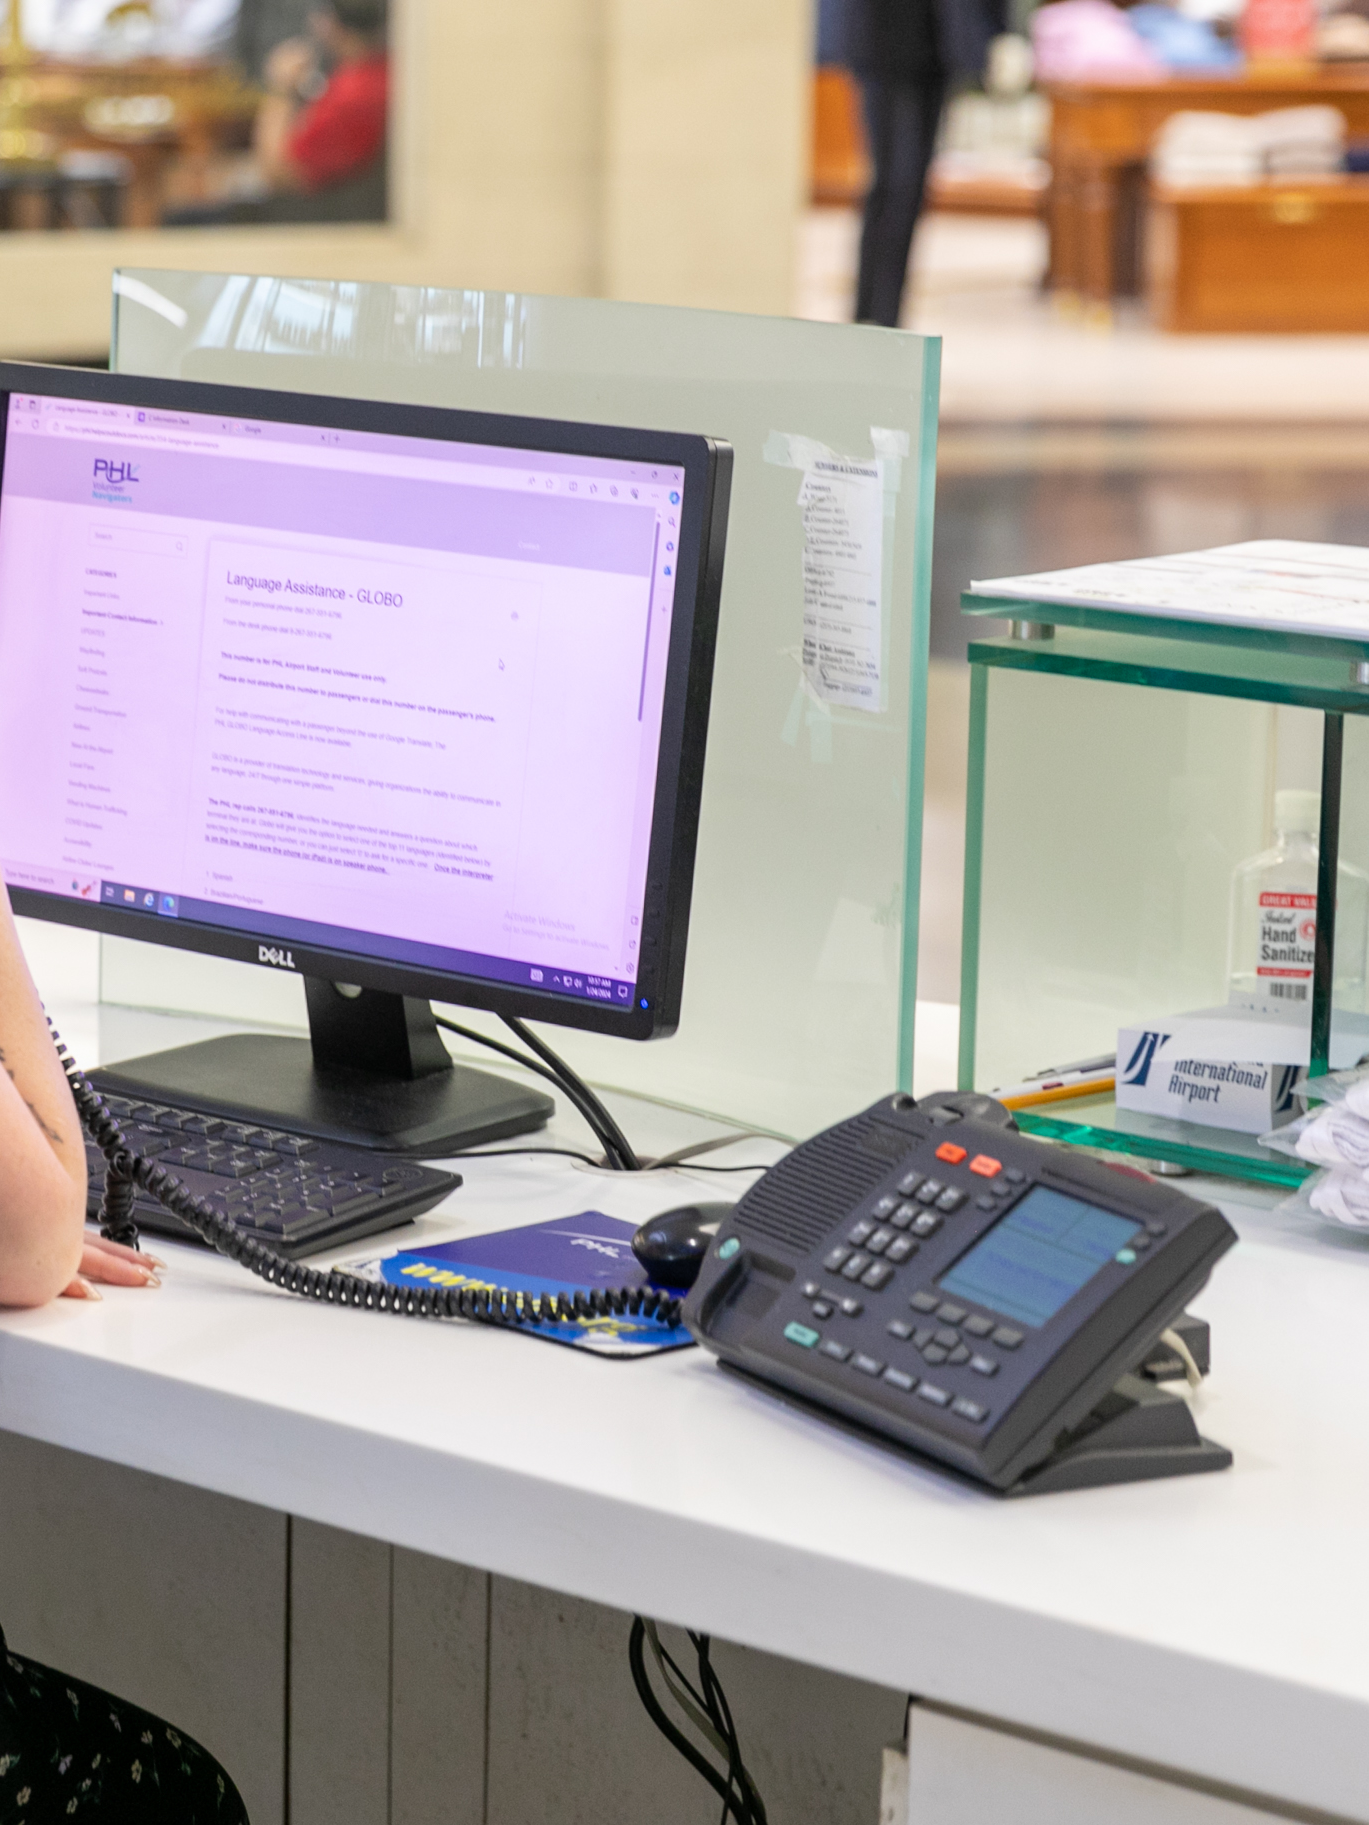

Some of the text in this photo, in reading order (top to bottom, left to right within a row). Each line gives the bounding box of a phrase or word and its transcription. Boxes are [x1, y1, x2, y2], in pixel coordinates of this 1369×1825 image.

[93, 458, 140, 483] PHL
[226, 570, 282, 594] Language
[284, 578, 346, 600] Assistance
[356, 587, 403, 608] GLOBO
[221, 651, 232, 659] This
[233, 653, 254, 663] number
[255, 656, 261, 664] is
[262, 657, 270, 665] for
[271, 659, 283, 667] PHL
[284, 661, 304, 672] Airport
[305, 664, 319, 673] Staff
[320, 666, 331, 674] and
[332, 668, 360, 679] Volunteer
[372, 675, 386, 684] only.
[218, 673, 237, 682] Please
[238, 676, 245, 684] do
[246, 677, 256, 685] not
[257, 679, 283, 689] distribute
[284, 683, 295, 691] this
[296, 685, 318, 695] number
[319, 688, 326, 696] to
[326, 691, 360, 703] passengers
[369, 696, 380, 705] dial
[381, 698, 392, 707] this
[393, 700, 416, 710] number
[426, 705, 436, 713] the
[437, 707, 473, 721] passenger's
[474, 712, 495, 724] phone.
[1262, 925, 1297, 943] Hand
[258, 944, 296, 968] DELL
[1261, 943, 1315, 963] Sanitize
[1168, 1073, 1222, 1104] Airport
